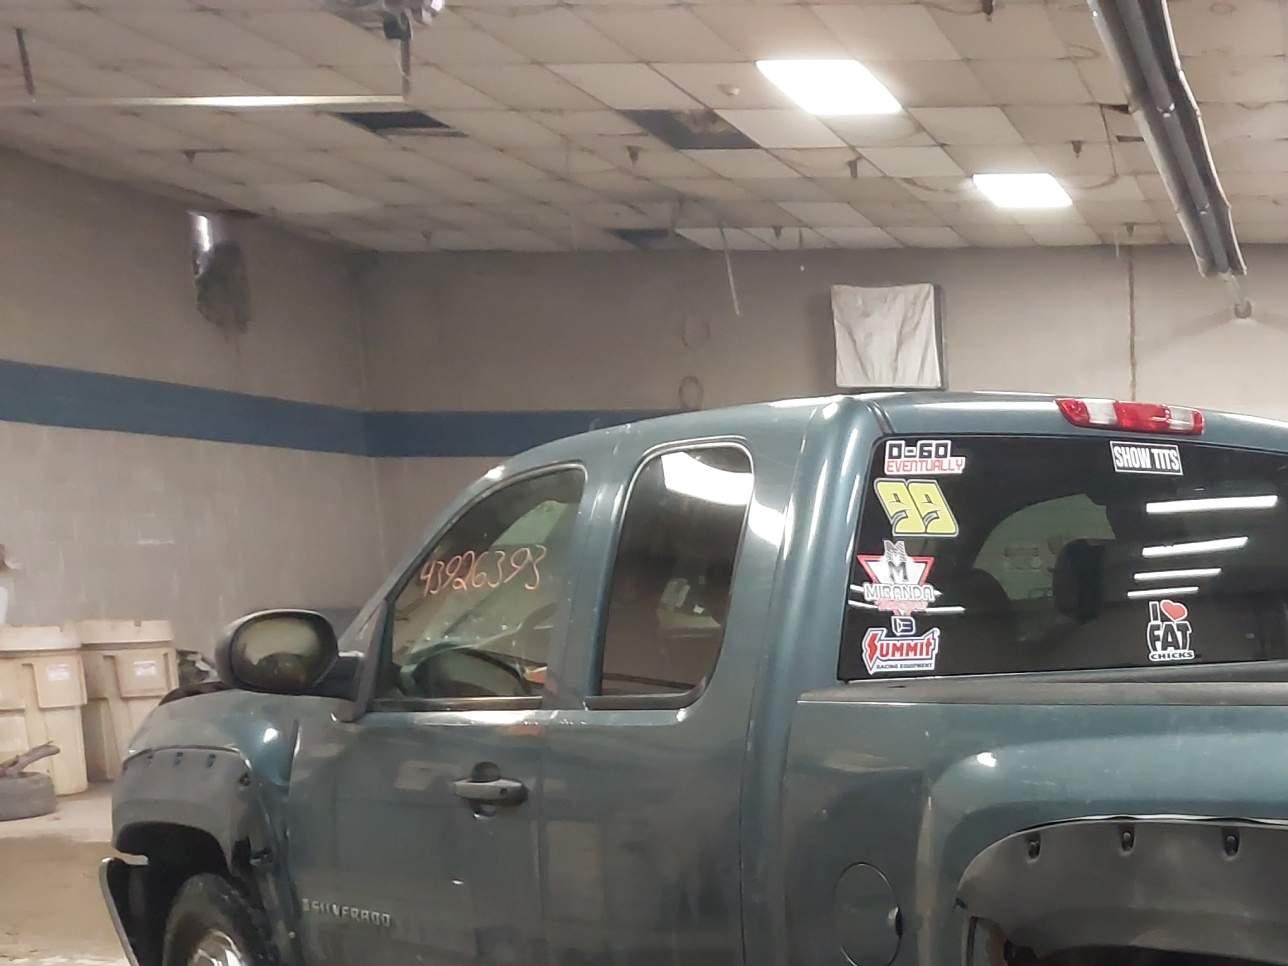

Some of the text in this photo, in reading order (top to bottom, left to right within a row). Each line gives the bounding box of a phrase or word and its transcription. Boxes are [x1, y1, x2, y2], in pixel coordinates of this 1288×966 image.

[886, 458, 964, 472] EVENTUALLY
[1113, 446, 1180, 470] SHOW TITS
[876, 480, 958, 535] 99
[421, 544, 547, 597] 43926393
[864, 585, 935, 601] MIRANDA
[1150, 602, 1160, 621] I
[1149, 623, 1190, 651] FAT
[1150, 651, 1193, 659] CHICKS
